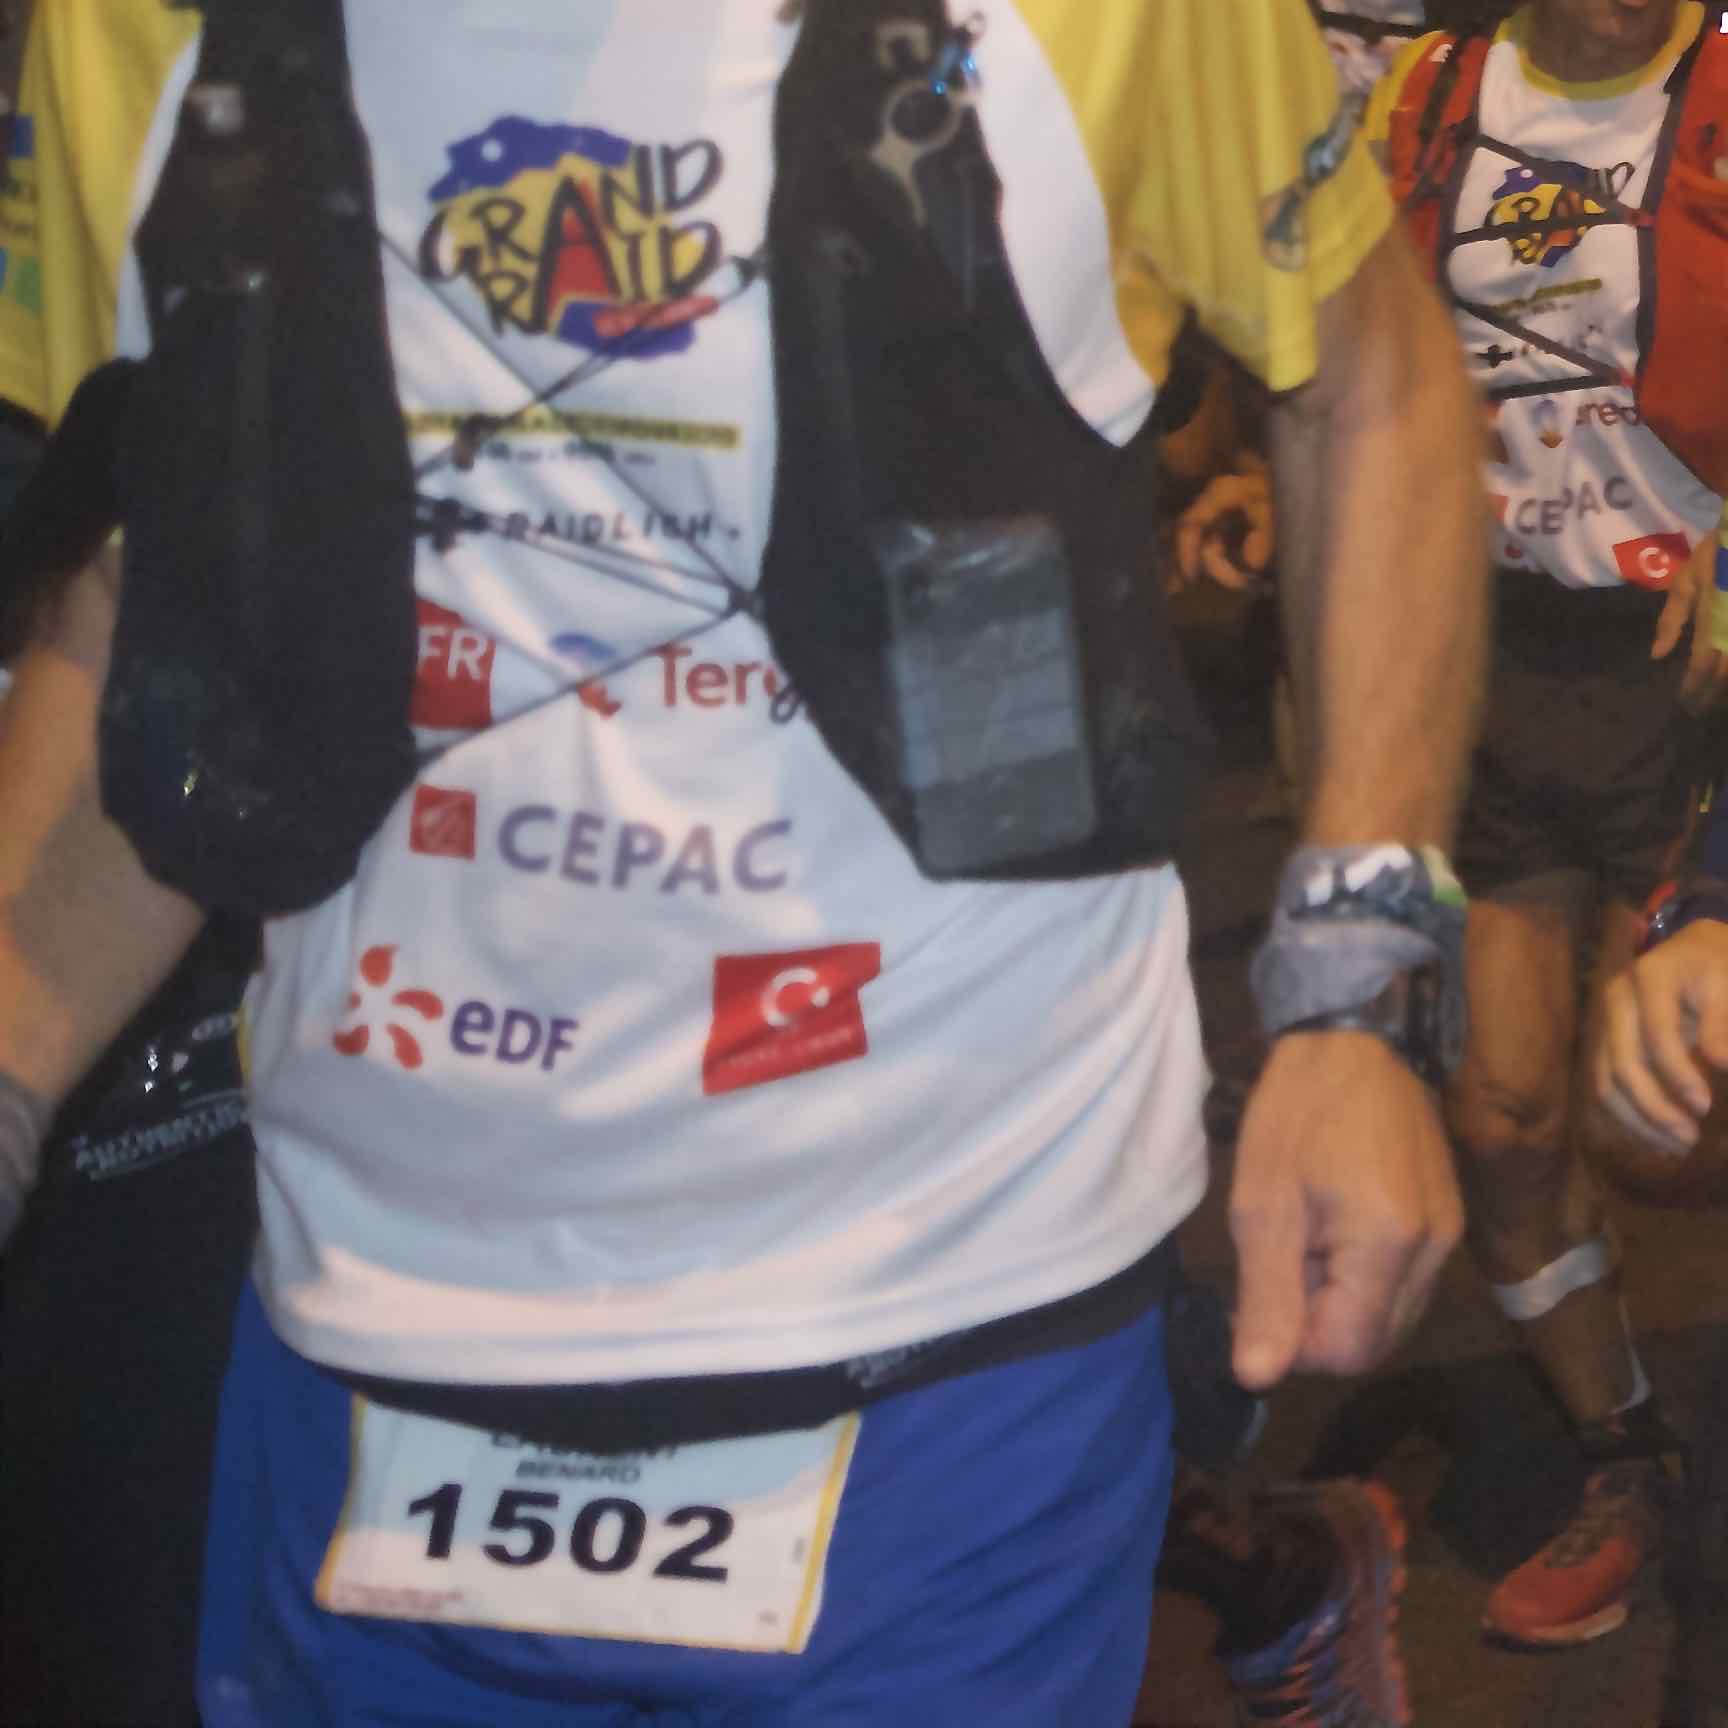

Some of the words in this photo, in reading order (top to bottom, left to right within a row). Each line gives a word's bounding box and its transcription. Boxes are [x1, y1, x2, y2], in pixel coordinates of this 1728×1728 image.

[418, 137, 724, 284] GRAND
[470, 207, 724, 337] RAID
[418, 624, 488, 682] FR
[499, 803, 792, 895] CEPAC
[450, 1000, 579, 1071] eDF
[406, 1483, 735, 1584] 1502
